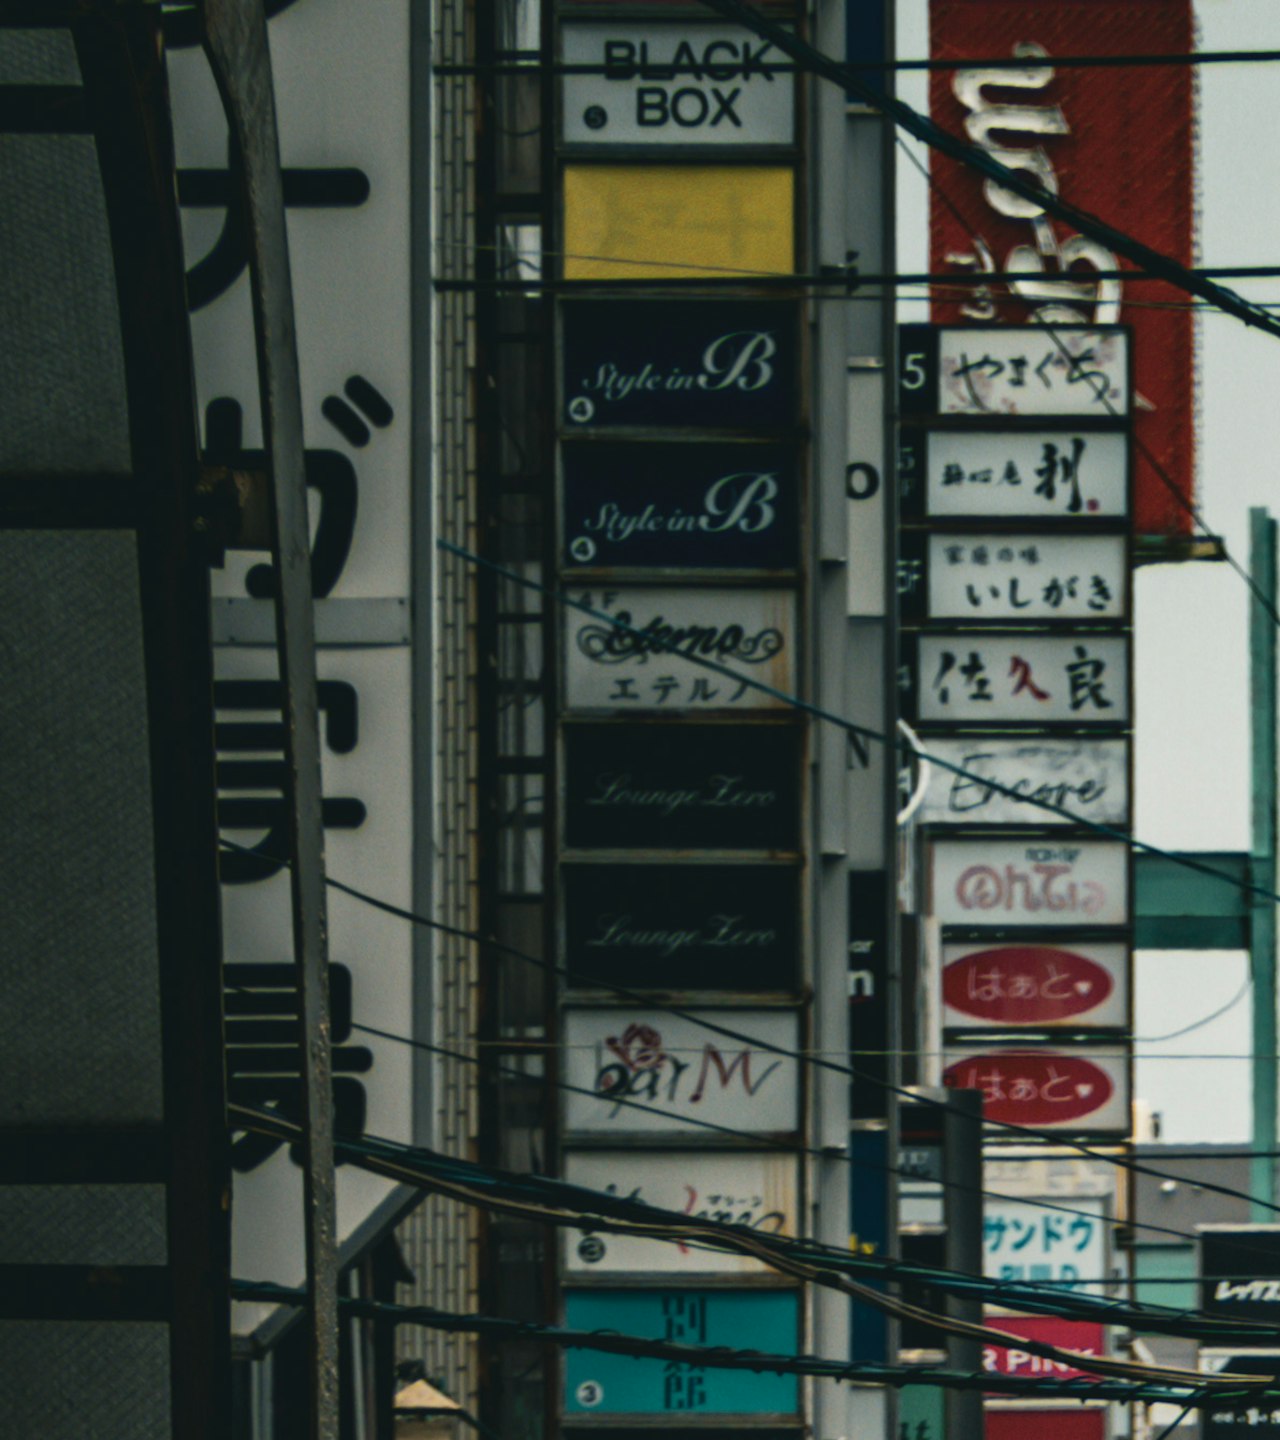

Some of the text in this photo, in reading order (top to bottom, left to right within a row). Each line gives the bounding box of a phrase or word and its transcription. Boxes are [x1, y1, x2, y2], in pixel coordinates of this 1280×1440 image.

[603, 40, 775, 82] BLACK
[636, 86, 742, 128] BOX
[583, 331, 777, 401] Style in B
[585, 471, 780, 543] Style in B
[966, 576, 1114, 611] いしがき
[609, 677, 749, 703] エテルノ
[933, 645, 1114, 710] 佐久良
[701, 773, 777, 807] Zero
[950, 752, 1108, 813] Encore
[701, 913, 777, 947] Zero
